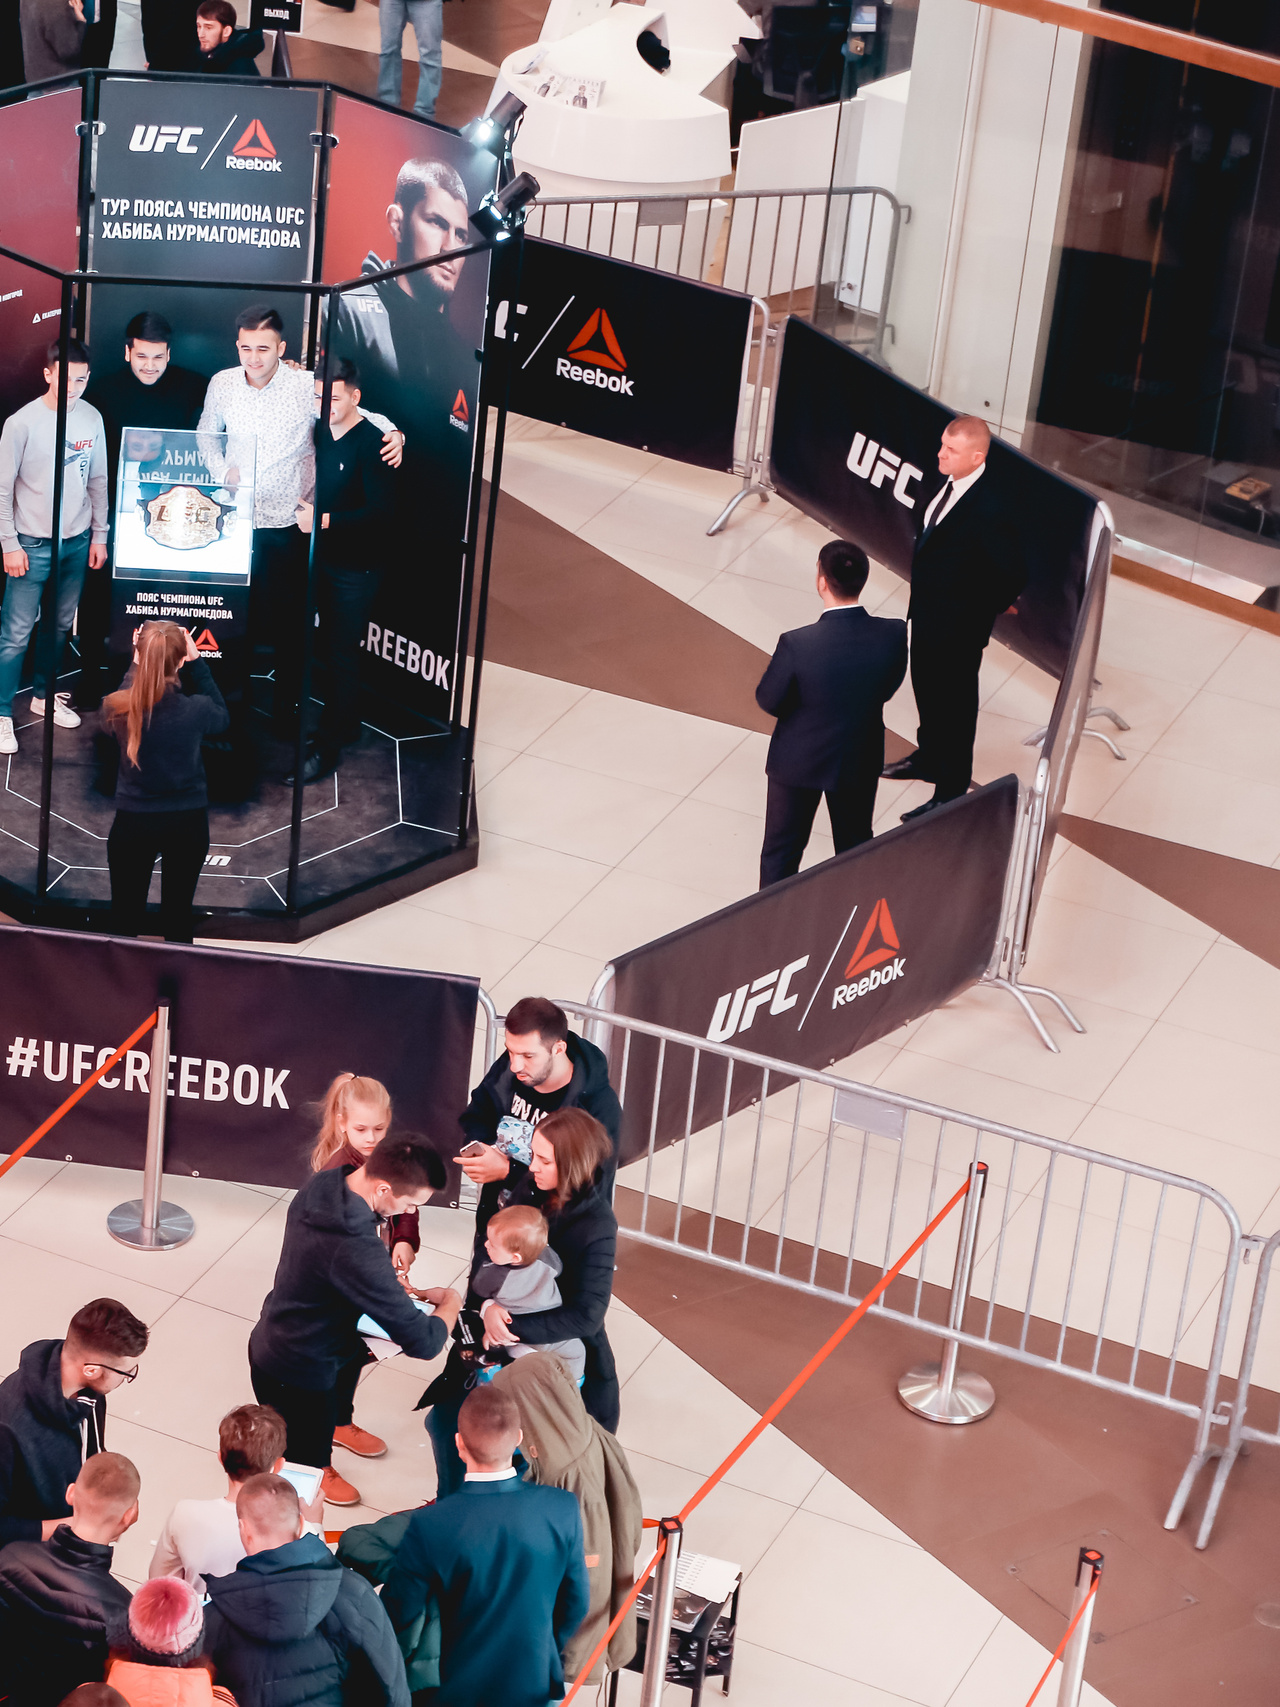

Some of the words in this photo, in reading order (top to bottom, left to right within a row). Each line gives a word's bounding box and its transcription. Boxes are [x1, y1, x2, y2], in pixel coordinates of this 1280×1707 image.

[263, 8, 290, 20] ВЫХОД
[128, 124, 204, 154] UFC
[225, 155, 283, 173] Reebok
[101, 198, 131, 216] ТУР
[133, 199, 185, 219] ПОЯСА
[188, 201, 273, 224] ЧЕМПИОНА
[275, 207, 305, 226] UFC
[101, 222, 163, 241] ХАБИБА
[166, 224, 302, 249] НУРМАГОМЕДОВА
[357, 298, 384, 314] UFC
[556, 357, 635, 396] Reebok
[846, 431, 924, 510] UFC
[125, 604, 159, 616] ХАБИБА
[160, 605, 233, 620] НУРМАГОМЕДОВА
[136, 592, 160, 603] ПОЯС
[160, 593, 206, 606] ЧЕМПИОНА
[207, 595, 224, 606] UFC
[199, 649, 223, 659] ebok
[831, 957, 907, 1010] Reebok
[706, 954, 810, 1043] UFC
